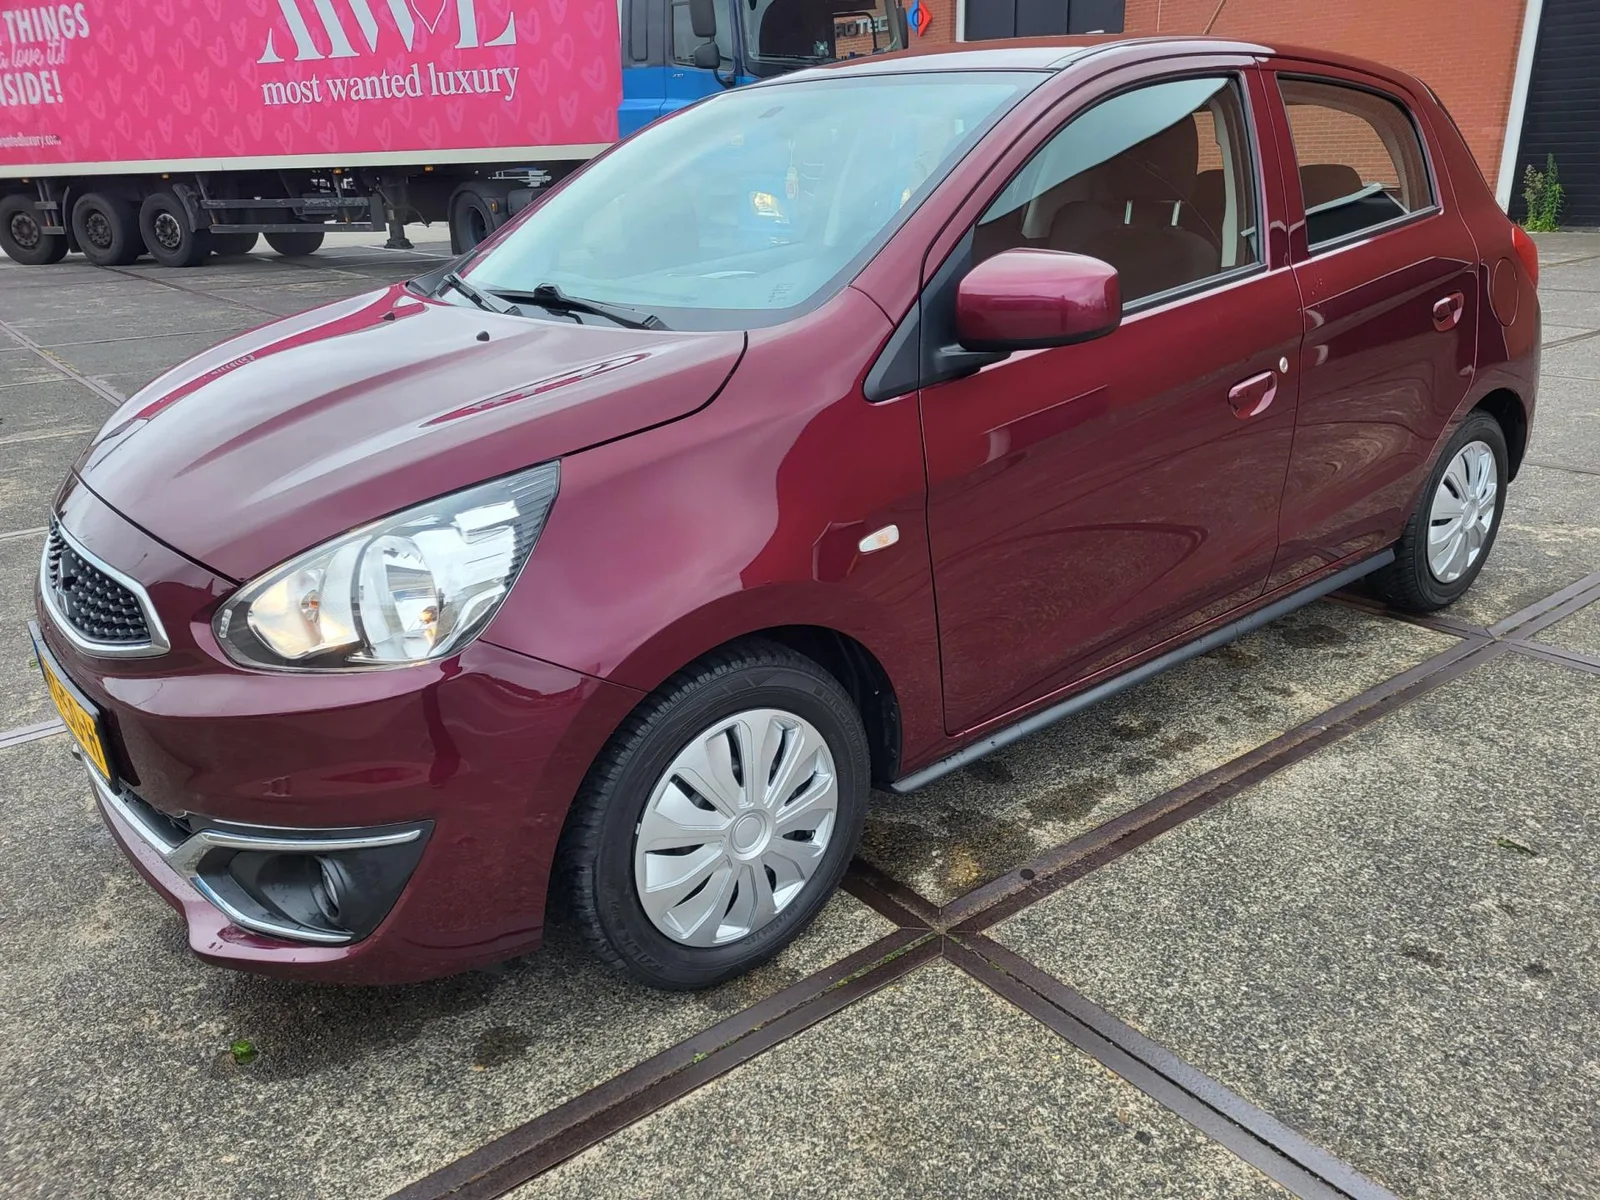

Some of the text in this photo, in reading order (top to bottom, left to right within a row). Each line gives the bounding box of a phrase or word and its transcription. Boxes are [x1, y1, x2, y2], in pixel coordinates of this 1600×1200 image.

[2, 2, 90, 44] THINGS
[261, 61, 520, 106] most wanted luxury
